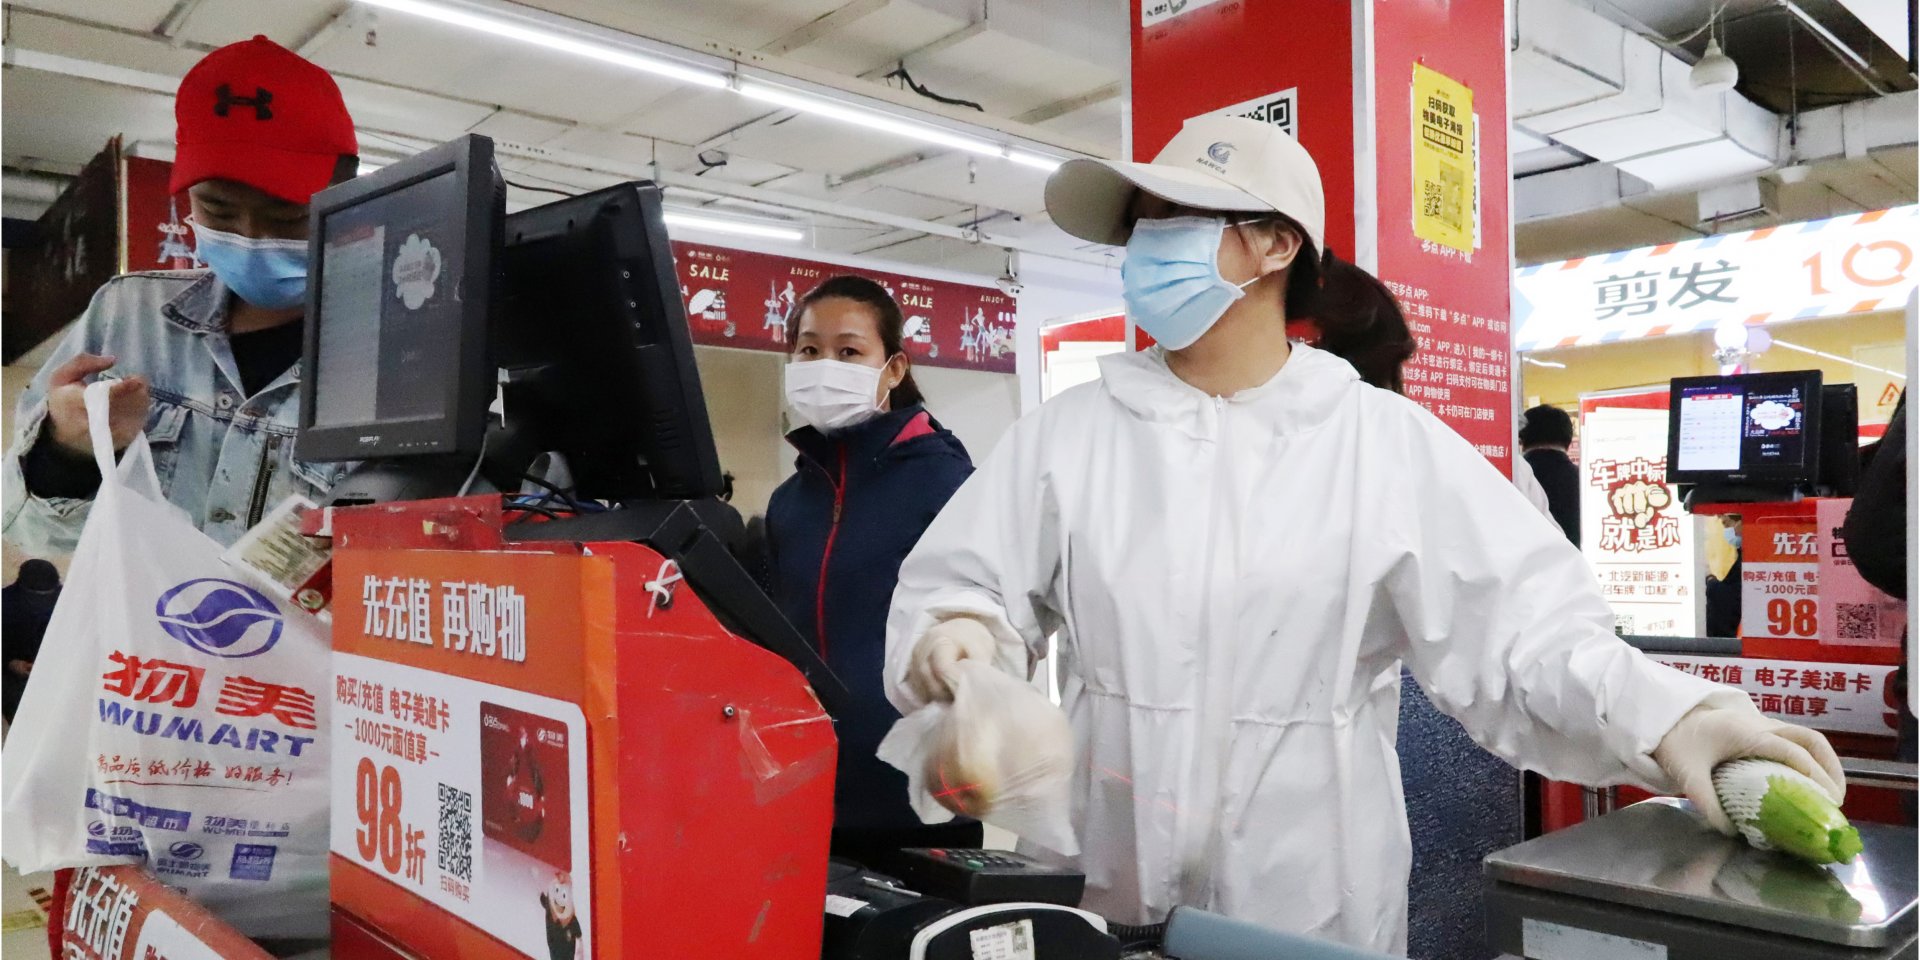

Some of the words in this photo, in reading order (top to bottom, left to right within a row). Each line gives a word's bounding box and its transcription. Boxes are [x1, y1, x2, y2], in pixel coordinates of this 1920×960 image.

[689, 263, 729, 281] SALE
[789, 266, 820, 279] ENJOY
[902, 293, 933, 308] SALE
[1592, 257, 1740, 321] 剪发
[1472, 316, 1484, 328] APP
[1430, 372, 1443, 383] APP
[1409, 384, 1423, 396] APP
[1424, 386, 1450, 400] 购物使用
[1600, 514, 1681, 553] 就是你
[1609, 570, 1669, 582] 北汽新能源
[1743, 571, 1797, 583] 购买/充值
[1803, 571, 1819, 583] 电
[363, 575, 433, 646] 先充值
[441, 580, 526, 664] 再购物
[1766, 597, 1818, 637] 98
[102, 650, 315, 730] 物美
[1755, 666, 1872, 694] 电子美通卡
[336, 674, 384, 715] 购买/充值
[390, 687, 450, 733] 电子美通卡
[98, 698, 315, 757] WUMART
[147, 758, 216, 781] 低价格
[204, 815, 247, 829] 物美
[440, 875, 470, 903] 扫码购买
